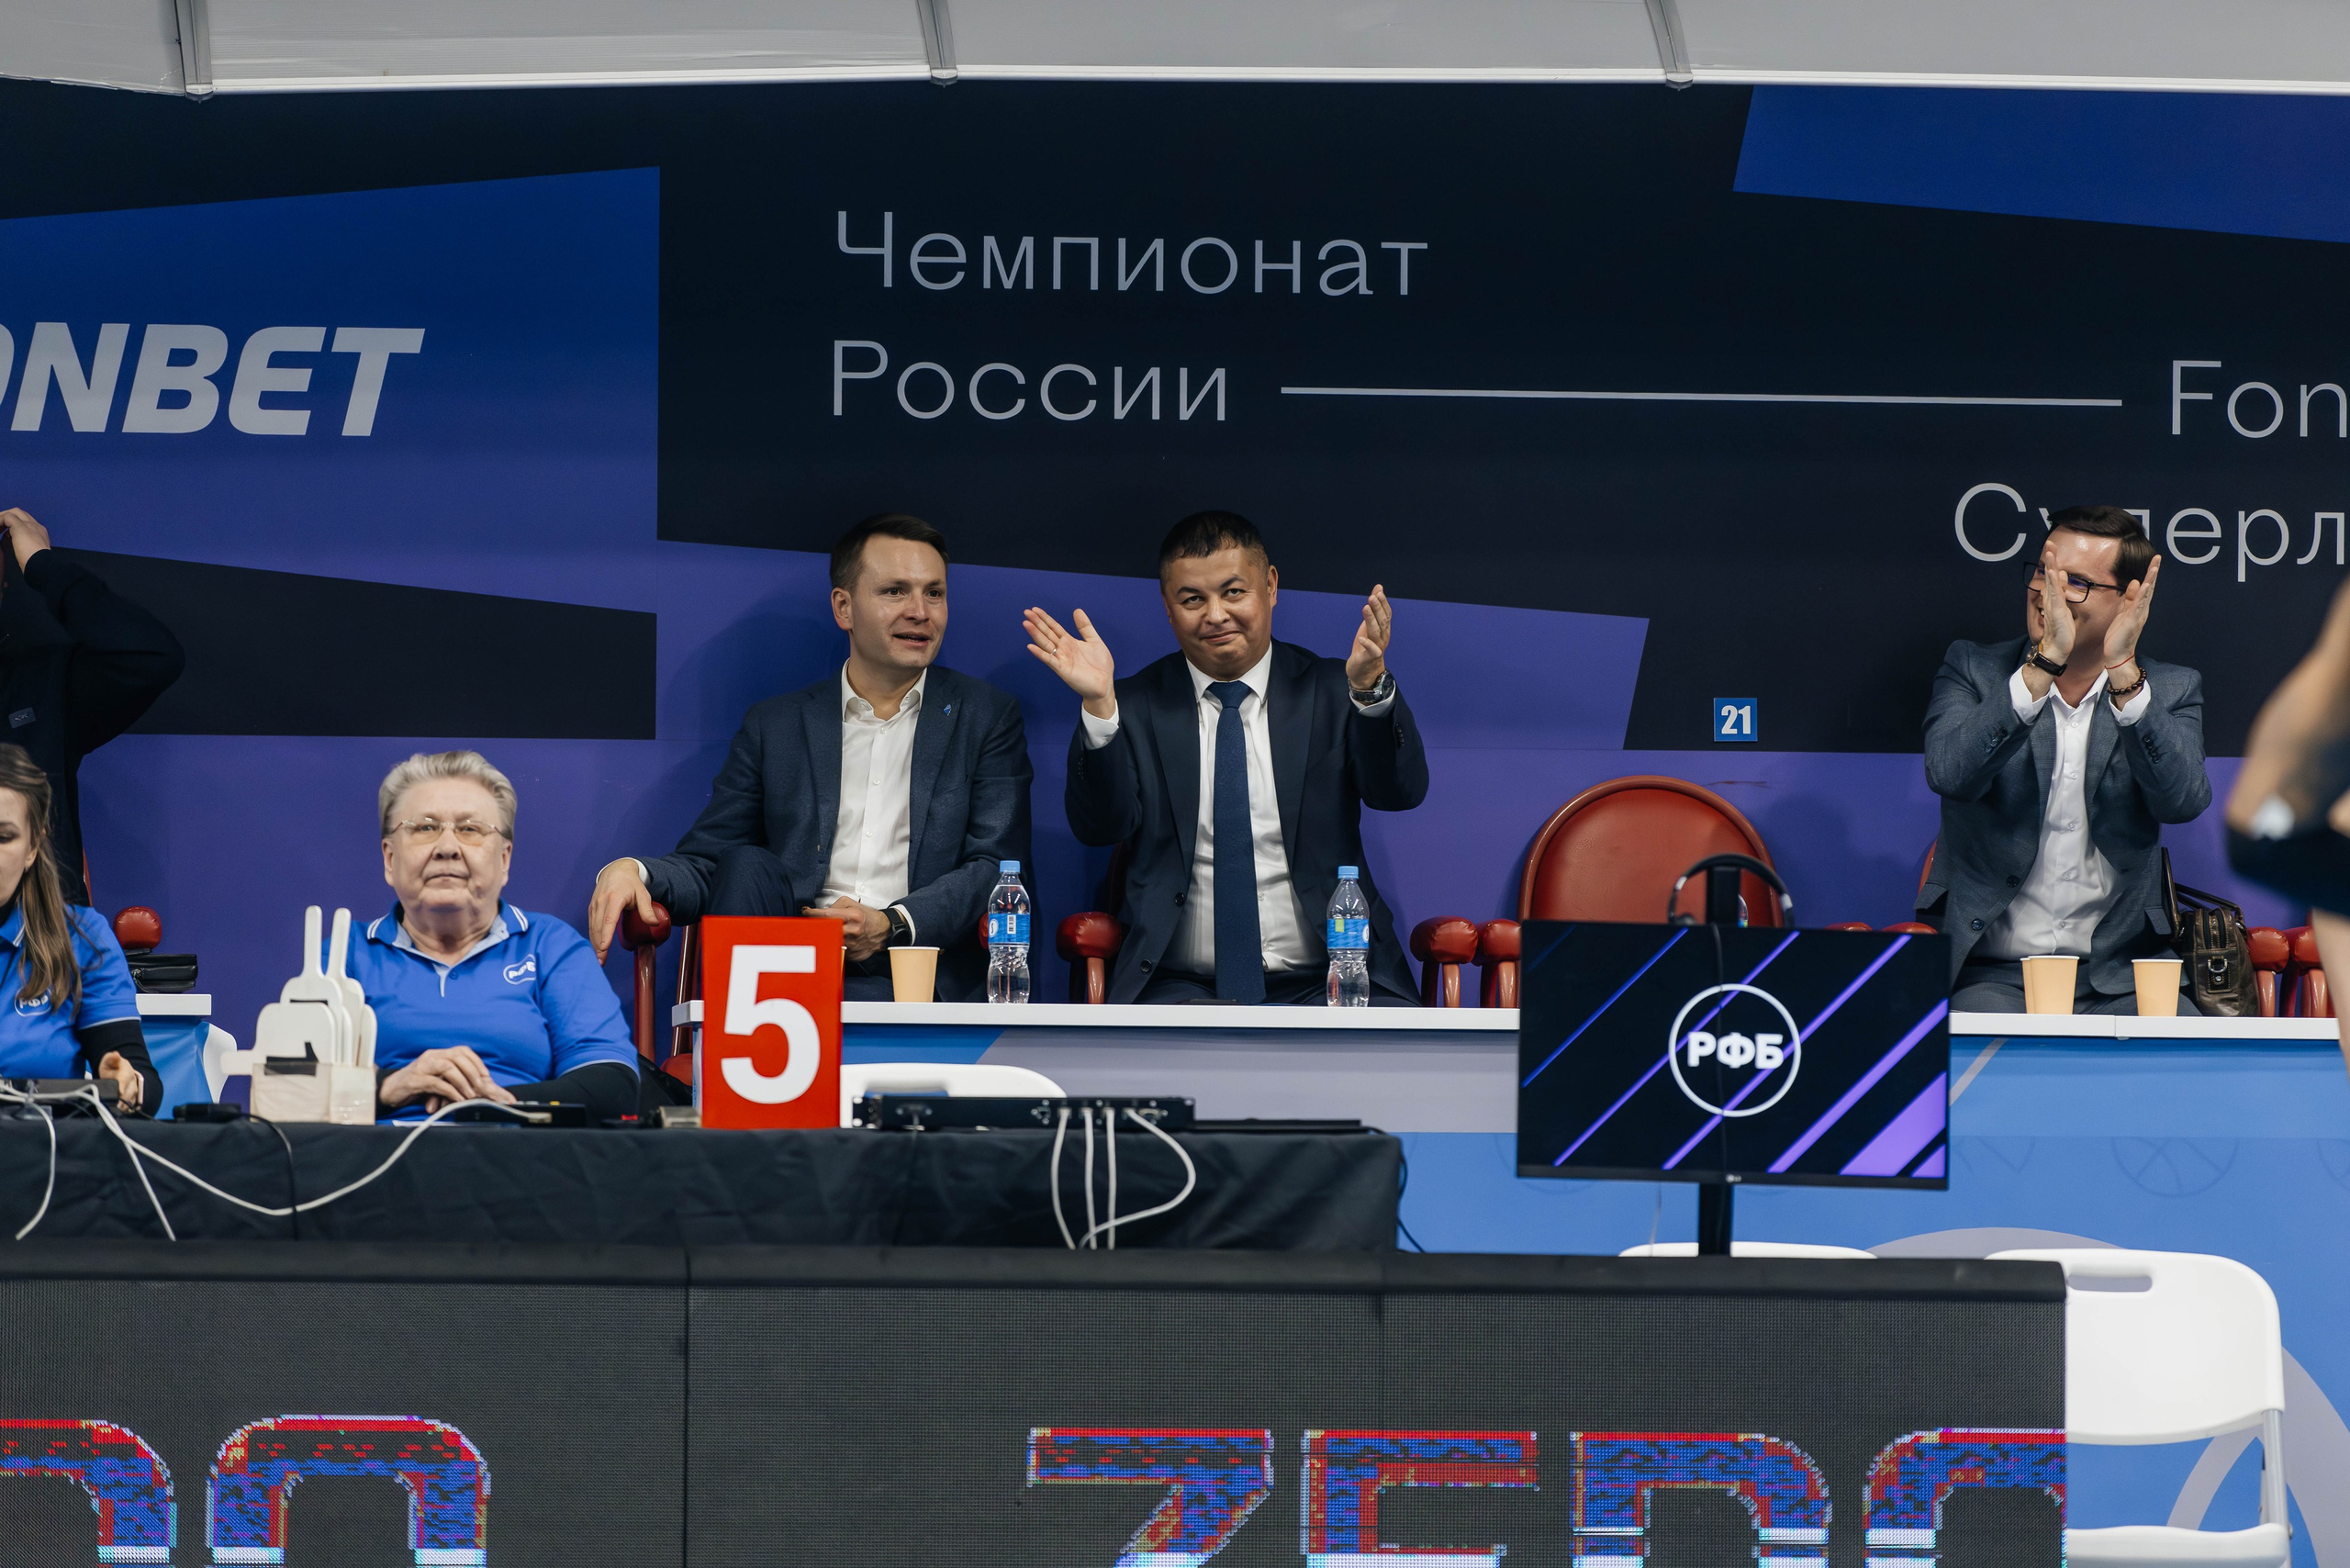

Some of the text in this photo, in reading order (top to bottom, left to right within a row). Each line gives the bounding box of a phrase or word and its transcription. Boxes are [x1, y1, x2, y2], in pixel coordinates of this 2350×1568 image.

[837, 211, 1428, 296] Чемпионат
[0, 322, 425, 436] NBET
[834, 340, 1226, 421] России
[2172, 361, 2348, 439] Fon
[1955, 482, 2345, 583] Серл
[1722, 706, 1751, 734] 21
[721, 946, 821, 1104] 5
[1687, 1031, 1785, 1070] РФБ
